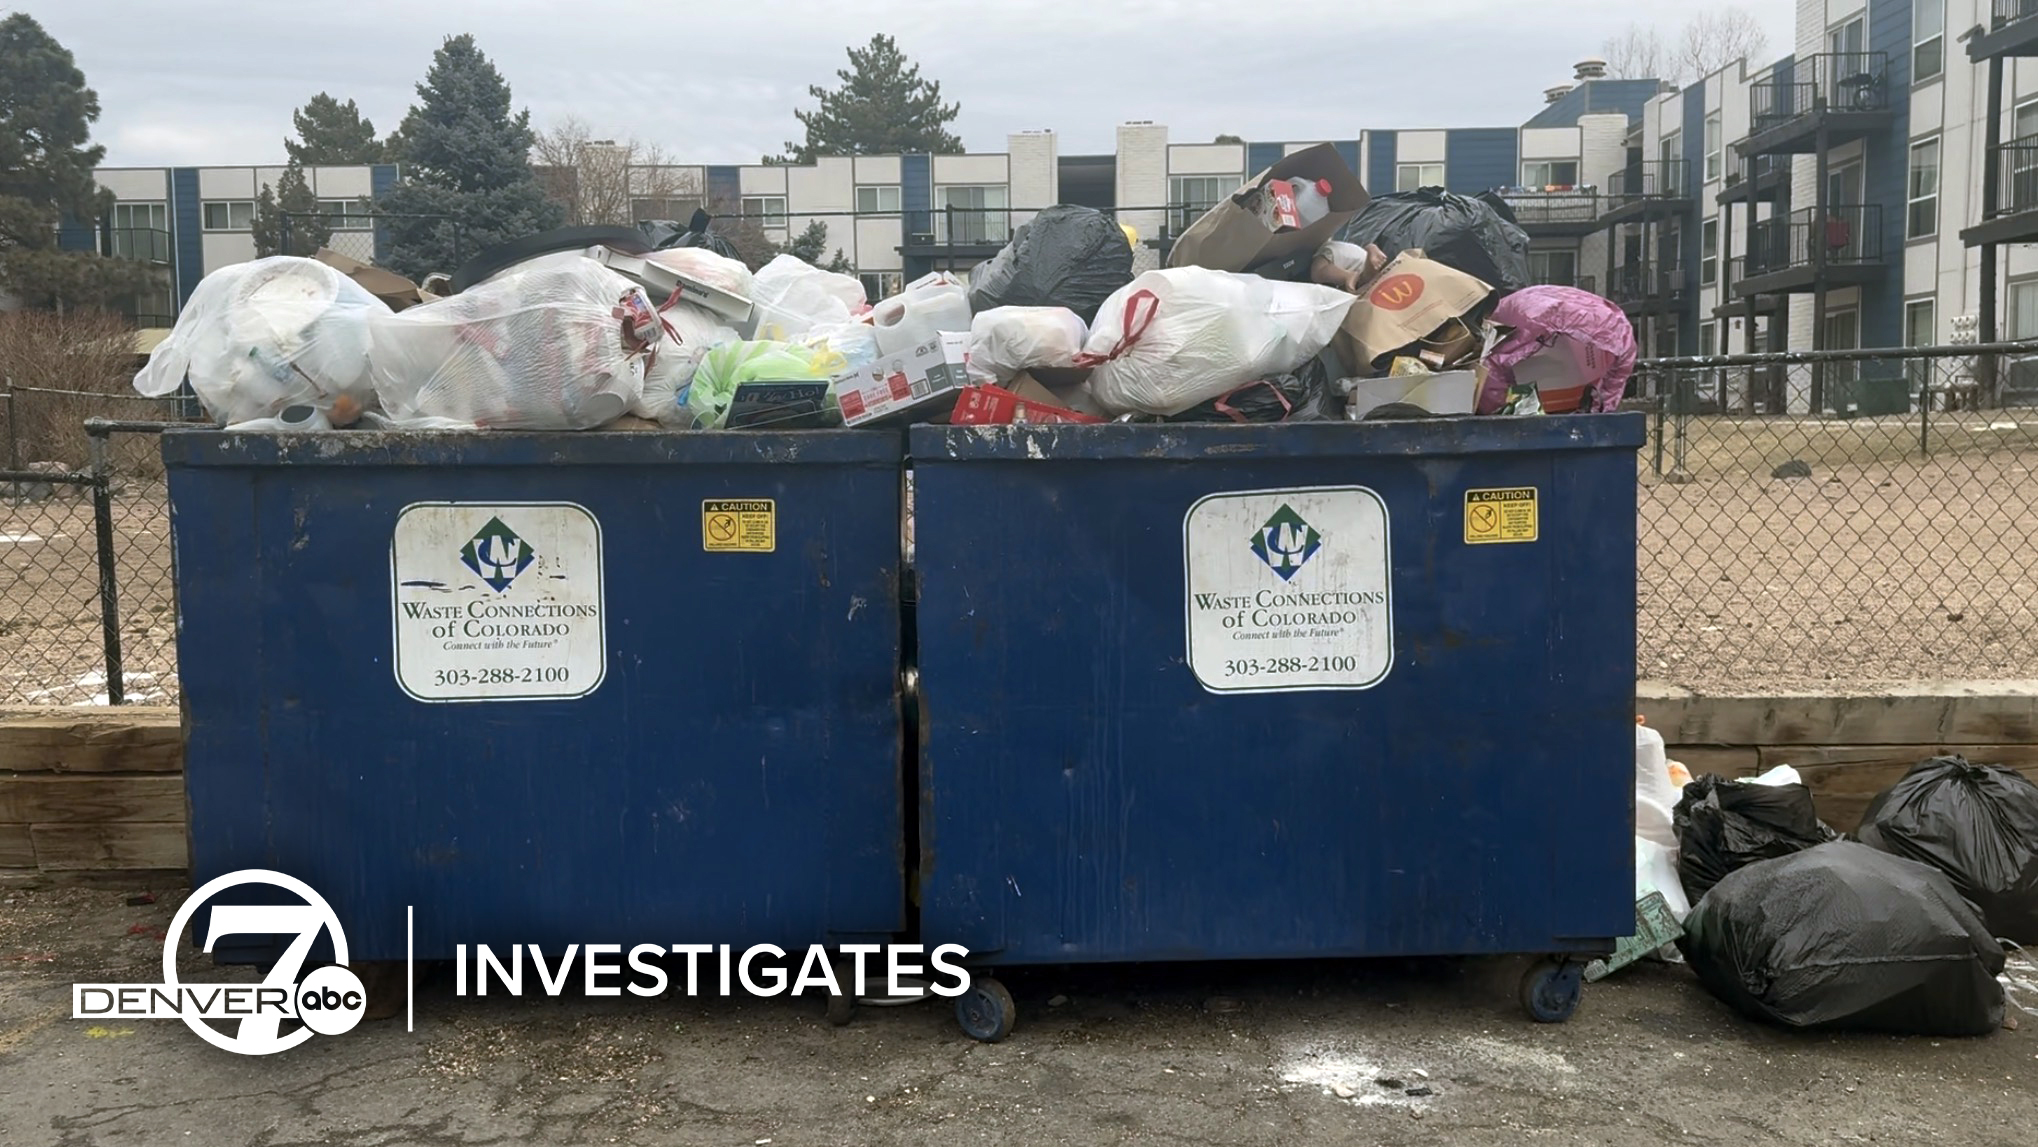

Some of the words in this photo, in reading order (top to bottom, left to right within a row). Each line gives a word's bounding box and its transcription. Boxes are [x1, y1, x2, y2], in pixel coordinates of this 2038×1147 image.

[1482, 491, 1530, 500] CAUTION
[721, 503, 767, 511] CAUTION
[1194, 593, 1251, 611] WASTE
[1256, 590, 1384, 608] CONNECTIONS
[402, 602, 463, 619] WASTE
[467, 601, 597, 619] CONNECTIONS
[1222, 611, 1248, 628] of
[1252, 609, 1356, 627] COLORADO
[432, 620, 457, 638] of
[464, 620, 570, 637] COLORADO
[1232, 629, 1270, 641] Connect
[1271, 629, 1291, 639] with
[1293, 629, 1308, 638] the
[443, 640, 482, 651] Connect
[483, 639, 504, 650] with
[506, 640, 521, 649] the
[1225, 656, 1356, 677] 303-288-2100
[434, 667, 569, 686] 303-288-2100
